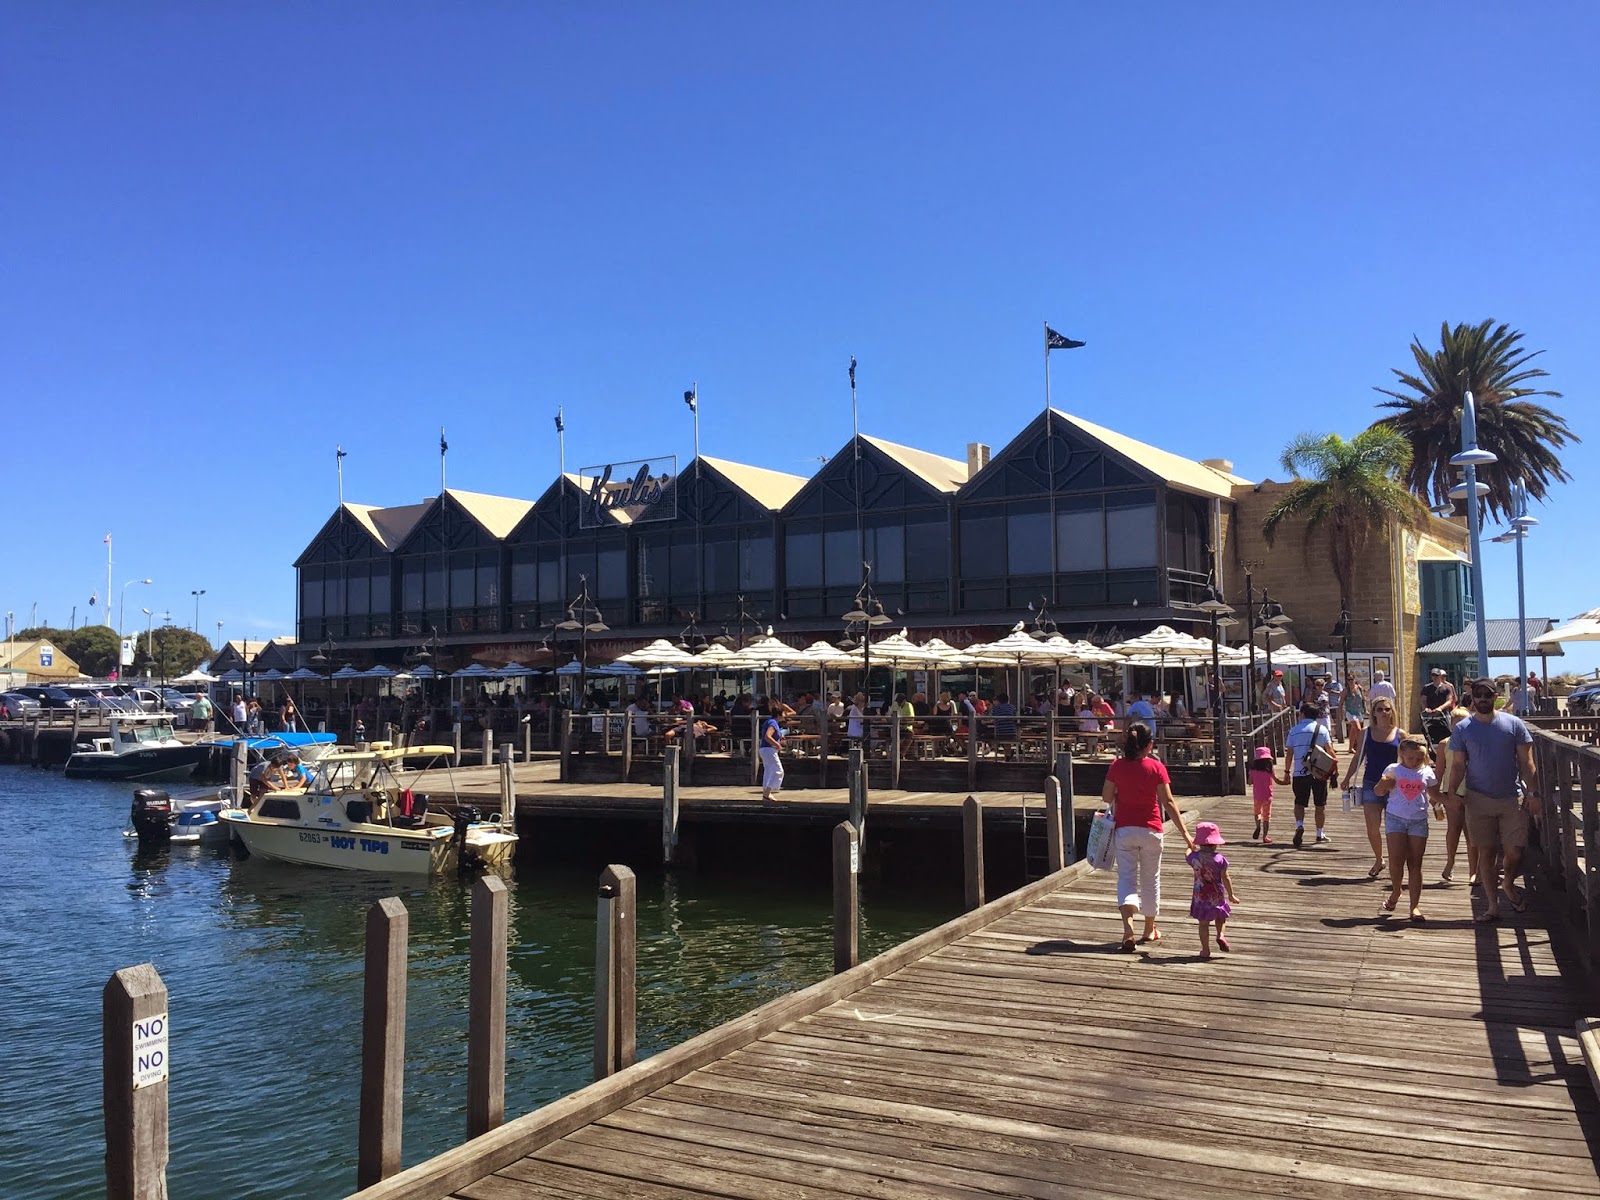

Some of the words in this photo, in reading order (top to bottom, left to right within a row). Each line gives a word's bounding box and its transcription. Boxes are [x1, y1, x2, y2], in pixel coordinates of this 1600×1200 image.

[1400, 783, 1423, 791] LOVE
[331, 835, 356, 850] HOT
[360, 838, 389, 854] TIPS
[137, 1019, 163, 1040] NO
[134, 1036, 167, 1051] SWIMMING
[138, 1051, 163, 1072] NO
[140, 1070, 162, 1082] DIVING
